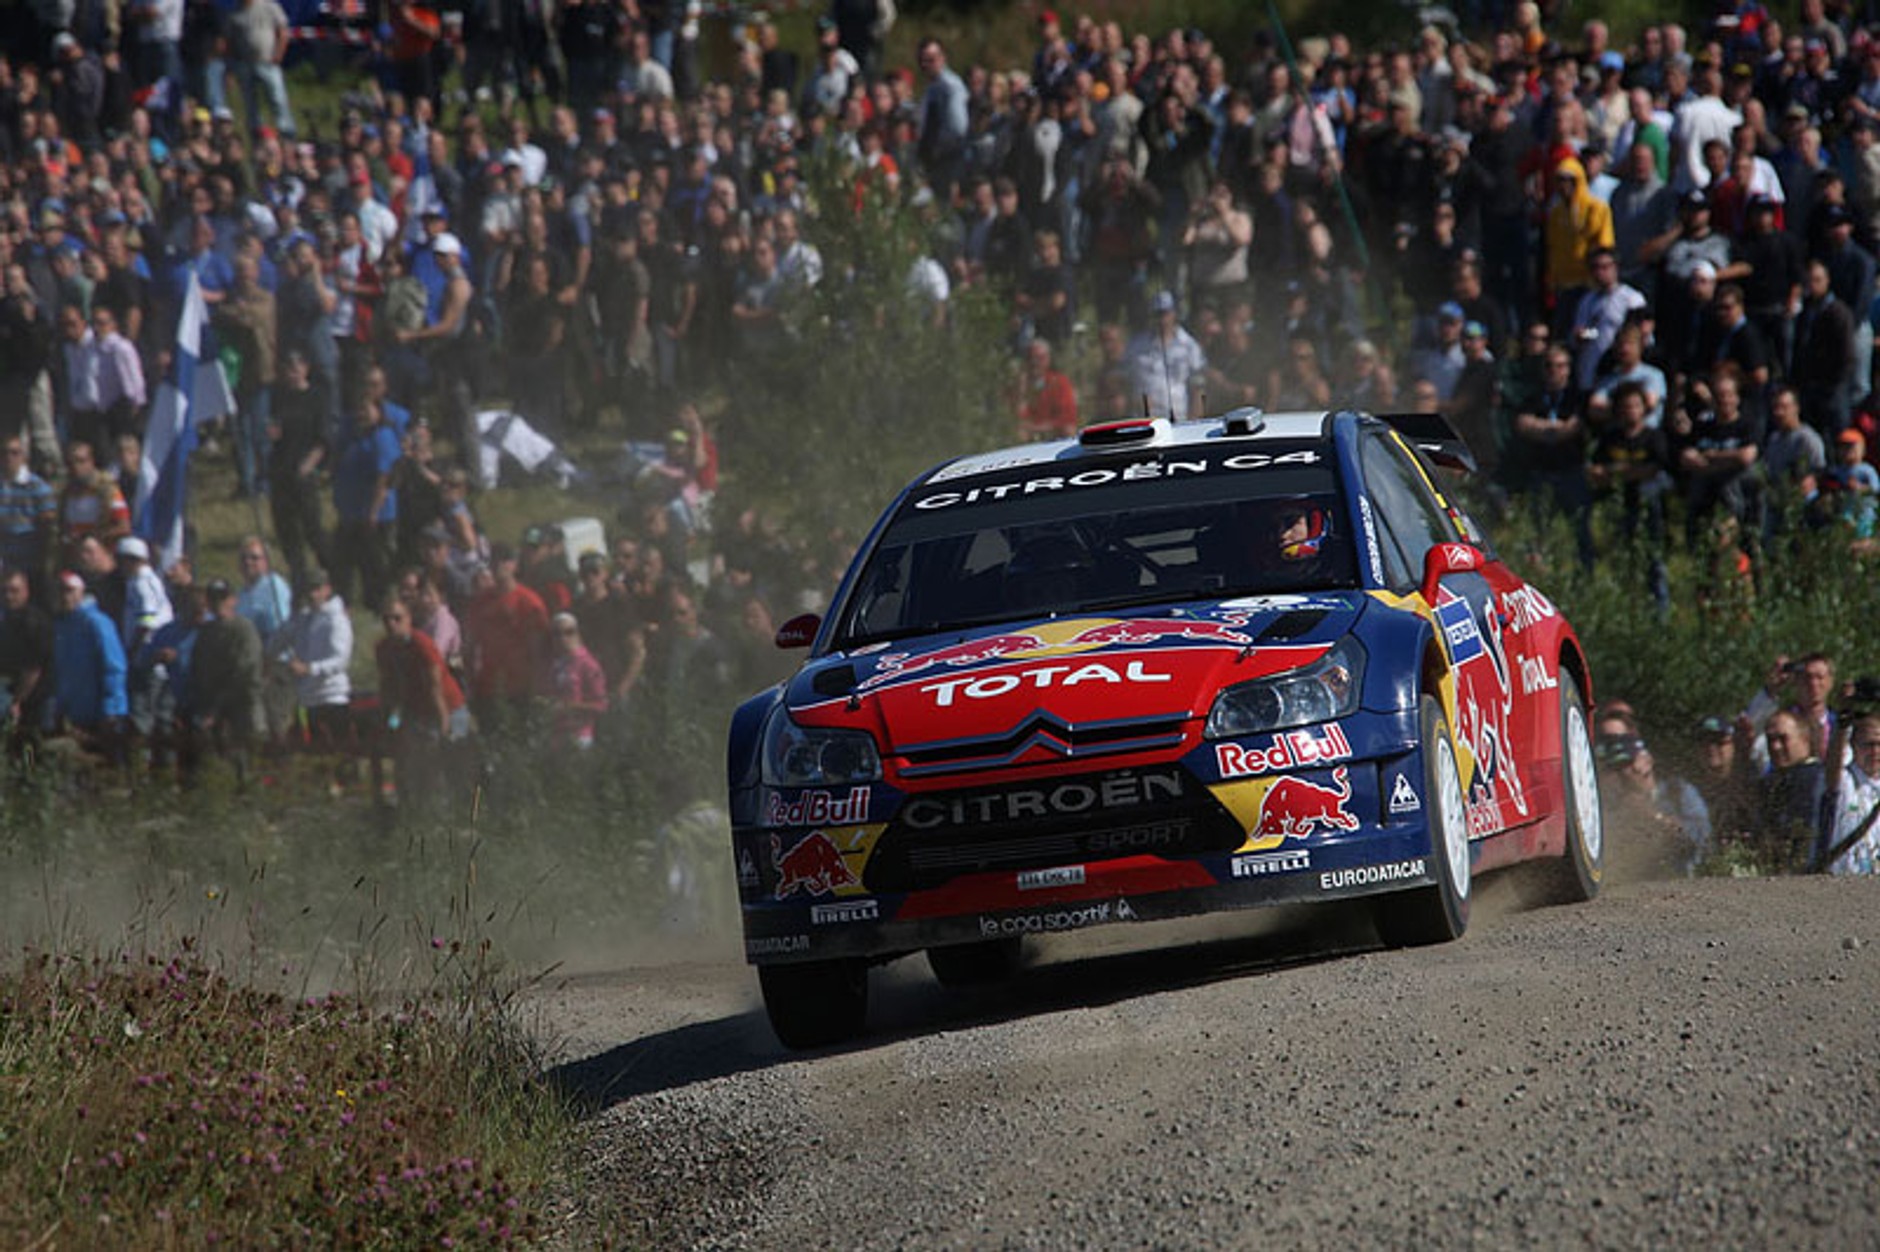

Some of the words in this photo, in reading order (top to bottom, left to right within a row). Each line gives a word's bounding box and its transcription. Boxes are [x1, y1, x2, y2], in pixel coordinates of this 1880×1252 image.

[915, 460, 1207, 509] CITROËN
[1222, 450, 1322, 470] C4
[921, 661, 1171, 706] TOTAL
[903, 770, 1184, 829] CITROËN
[1089, 823, 1190, 850] SPORT
[1231, 849, 1310, 877] PIRELLI
[1320, 859, 1426, 889] EURODATACAR
[811, 900, 879, 924] PIRELLI
